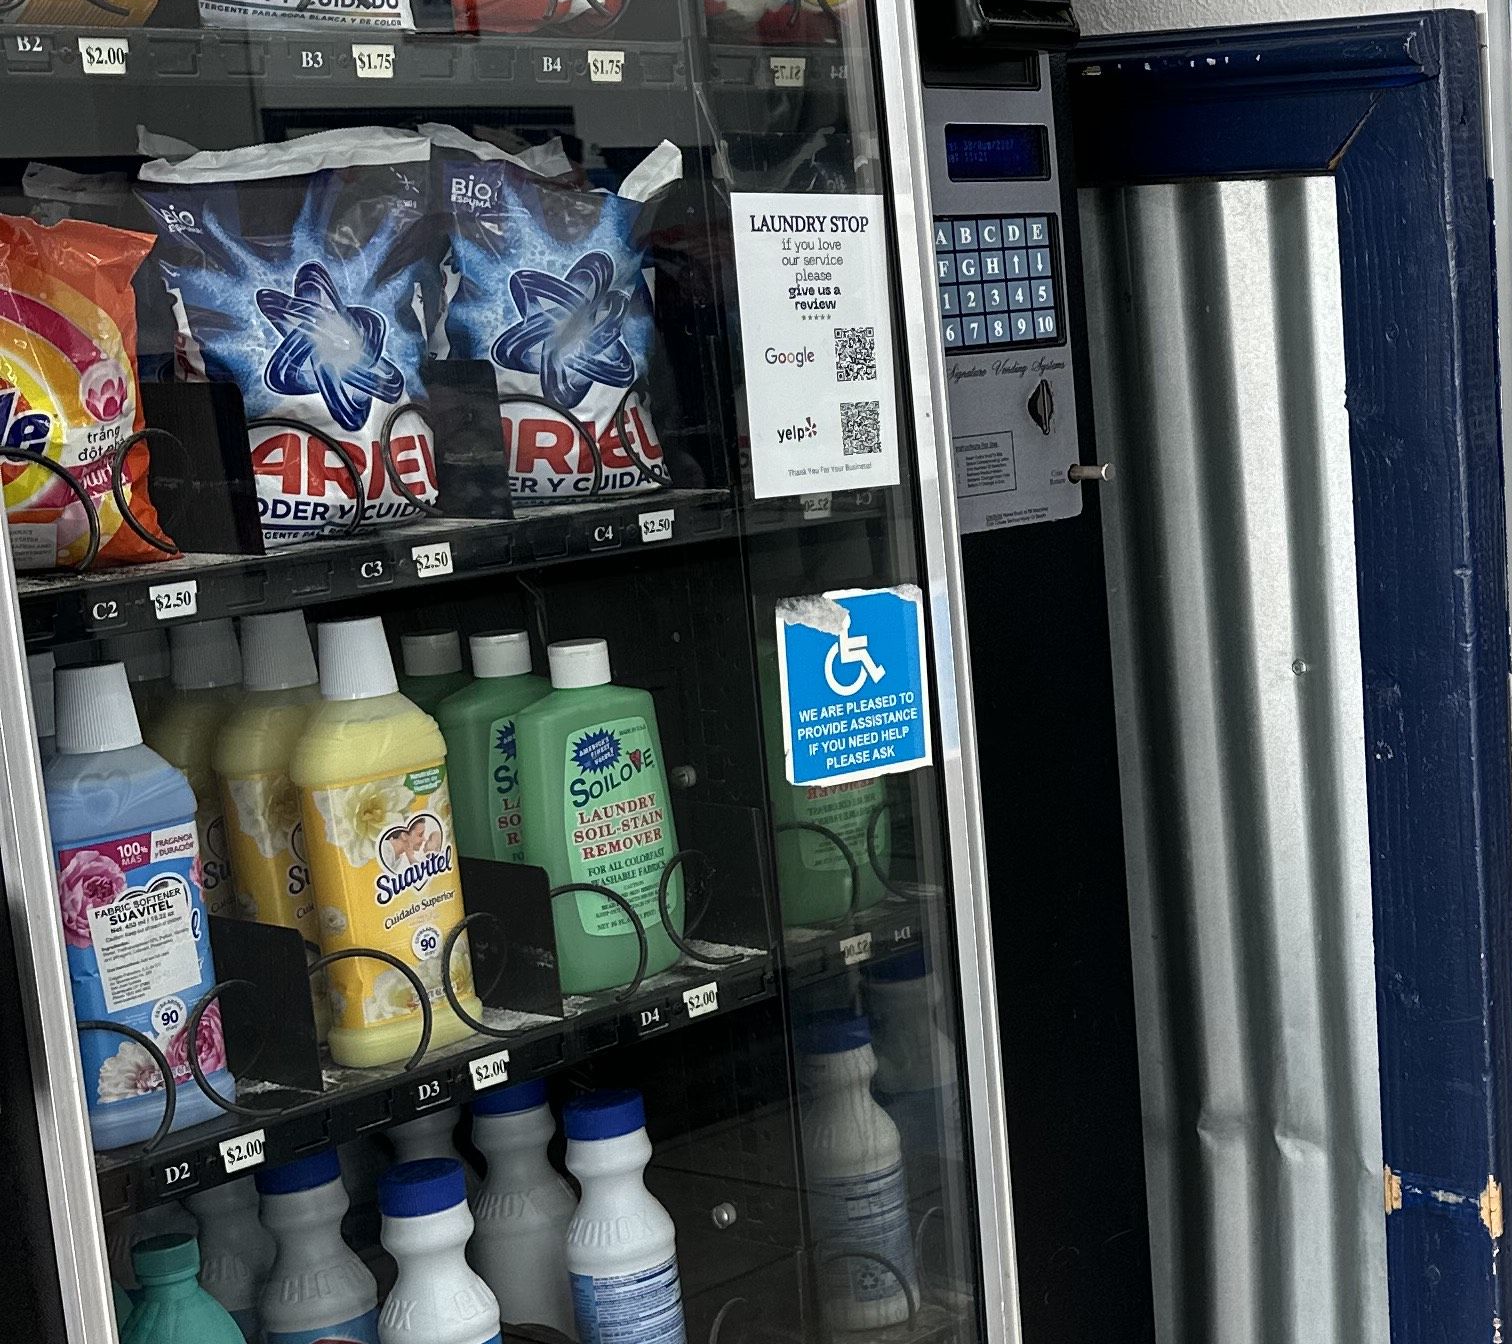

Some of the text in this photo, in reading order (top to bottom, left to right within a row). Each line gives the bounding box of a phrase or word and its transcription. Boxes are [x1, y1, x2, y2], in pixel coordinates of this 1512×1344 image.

[17, 36, 125, 66] B2 $2.00
[301, 50, 392, 70] B3 $1.75
[542, 57, 623, 76] B4 $1.75
[749, 214, 869, 234] LAUNDRY STOP
[935, 223, 1043, 246] A B C D E
[781, 236, 842, 254] if you love
[781, 253, 844, 266] our service
[938, 257, 1000, 278] F G H
[795, 267, 832, 285] please
[788, 283, 842, 300] give us a
[794, 297, 837, 311] review
[943, 285, 1047, 310] 1 2 3 4 5
[945, 315, 1053, 341] 6 7 8 9 10
[764, 345, 816, 368] Google
[776, 424, 806, 444] yelp
[251, 432, 438, 501] ARIEL
[546, 477, 566, 493] Y
[337, 501, 355, 520] Y
[593, 518, 670, 542] C4 $2.50
[360, 550, 449, 579] C3 $2.50
[92, 592, 193, 620] C2 $2.50
[798, 691, 915, 724] WE ARE PLEASED TO
[797, 707, 918, 741] PROVIDE ASSISTANCE
[808, 725, 910, 757] IF YOU NEED HELP
[825, 744, 896, 770] PLEASE ASK
[578, 793, 657, 825] LAUNDRY
[573, 807, 664, 845] SOIL-STAIN
[116, 842, 149, 857] 100%
[582, 826, 663, 861] REMOVER
[375, 844, 453, 906] Suavitel
[587, 864, 607, 877] FOR
[608, 859, 625, 873] ALL
[94, 887, 182, 920] FABRIC SOFTENER
[109, 901, 174, 927] SUAVITEL
[383, 889, 456, 930] Cuidado Superior
[420, 936, 437, 953] 90
[161, 1009, 179, 1026] 90
[640, 988, 717, 1028] D4 $2.00
[416, 1060, 507, 1103] D3 $2.00
[165, 1138, 263, 1185] D2 $2.00
